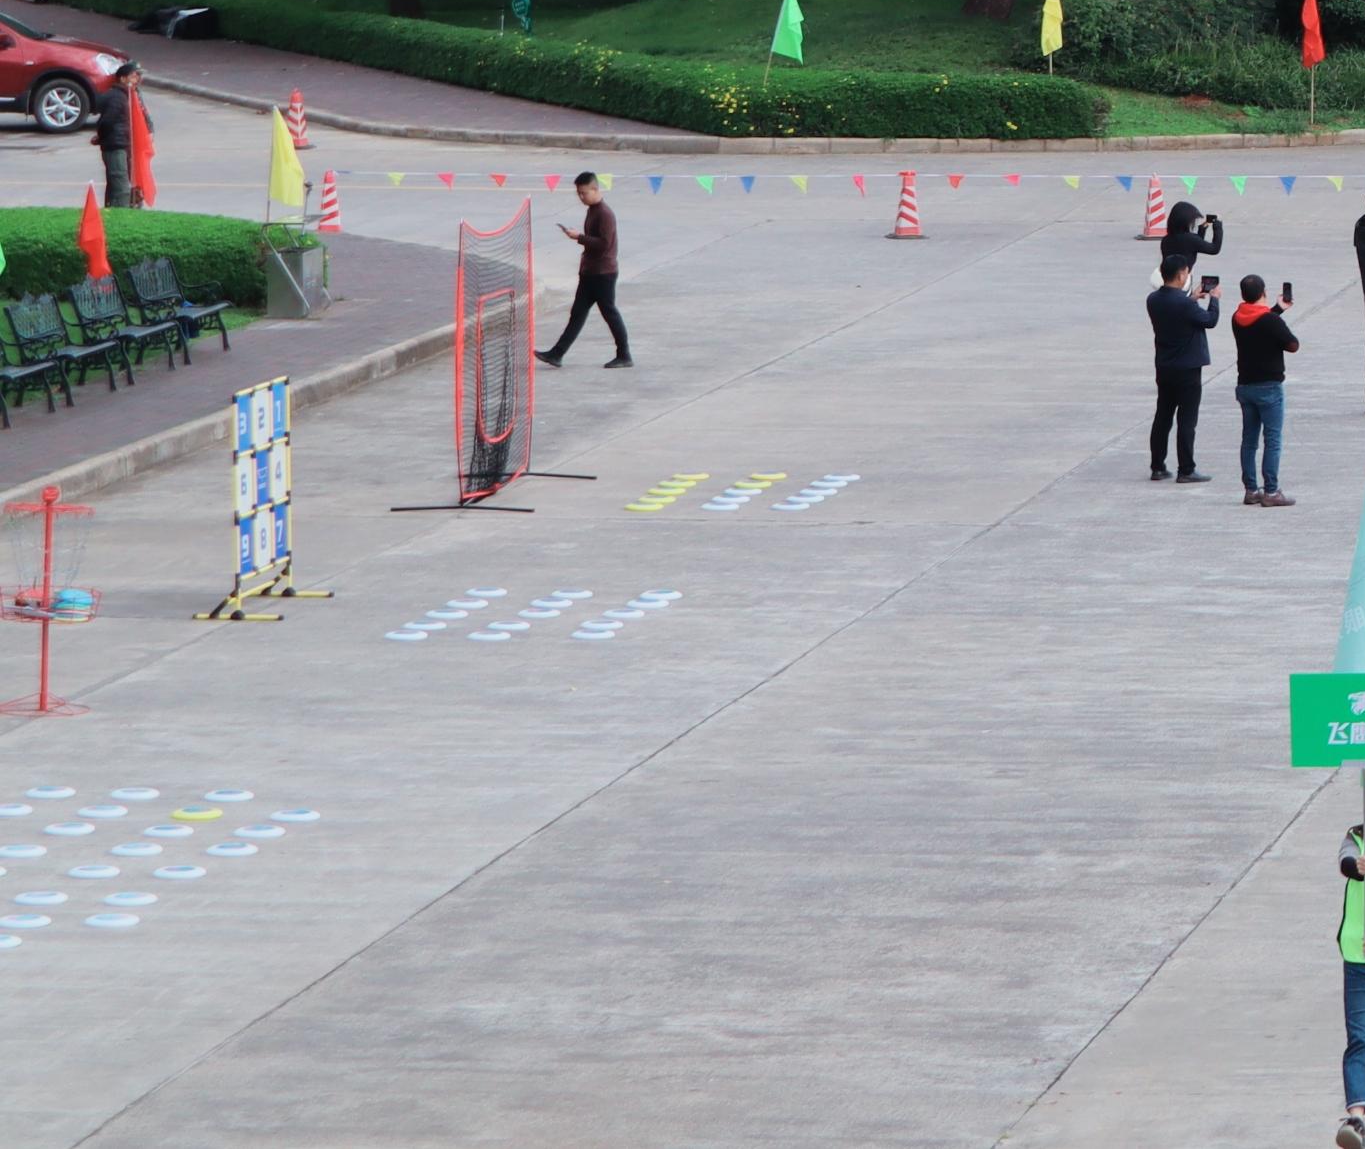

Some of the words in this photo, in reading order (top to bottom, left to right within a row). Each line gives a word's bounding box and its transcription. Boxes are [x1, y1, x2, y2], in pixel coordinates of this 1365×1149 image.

[239, 412, 247, 435] 3
[258, 407, 265, 430] 2
[240, 473, 247, 496] 6
[275, 460, 282, 482] 4
[241, 534, 249, 558] 9
[260, 528, 267, 550] 8
[276, 519, 283, 542] 7
